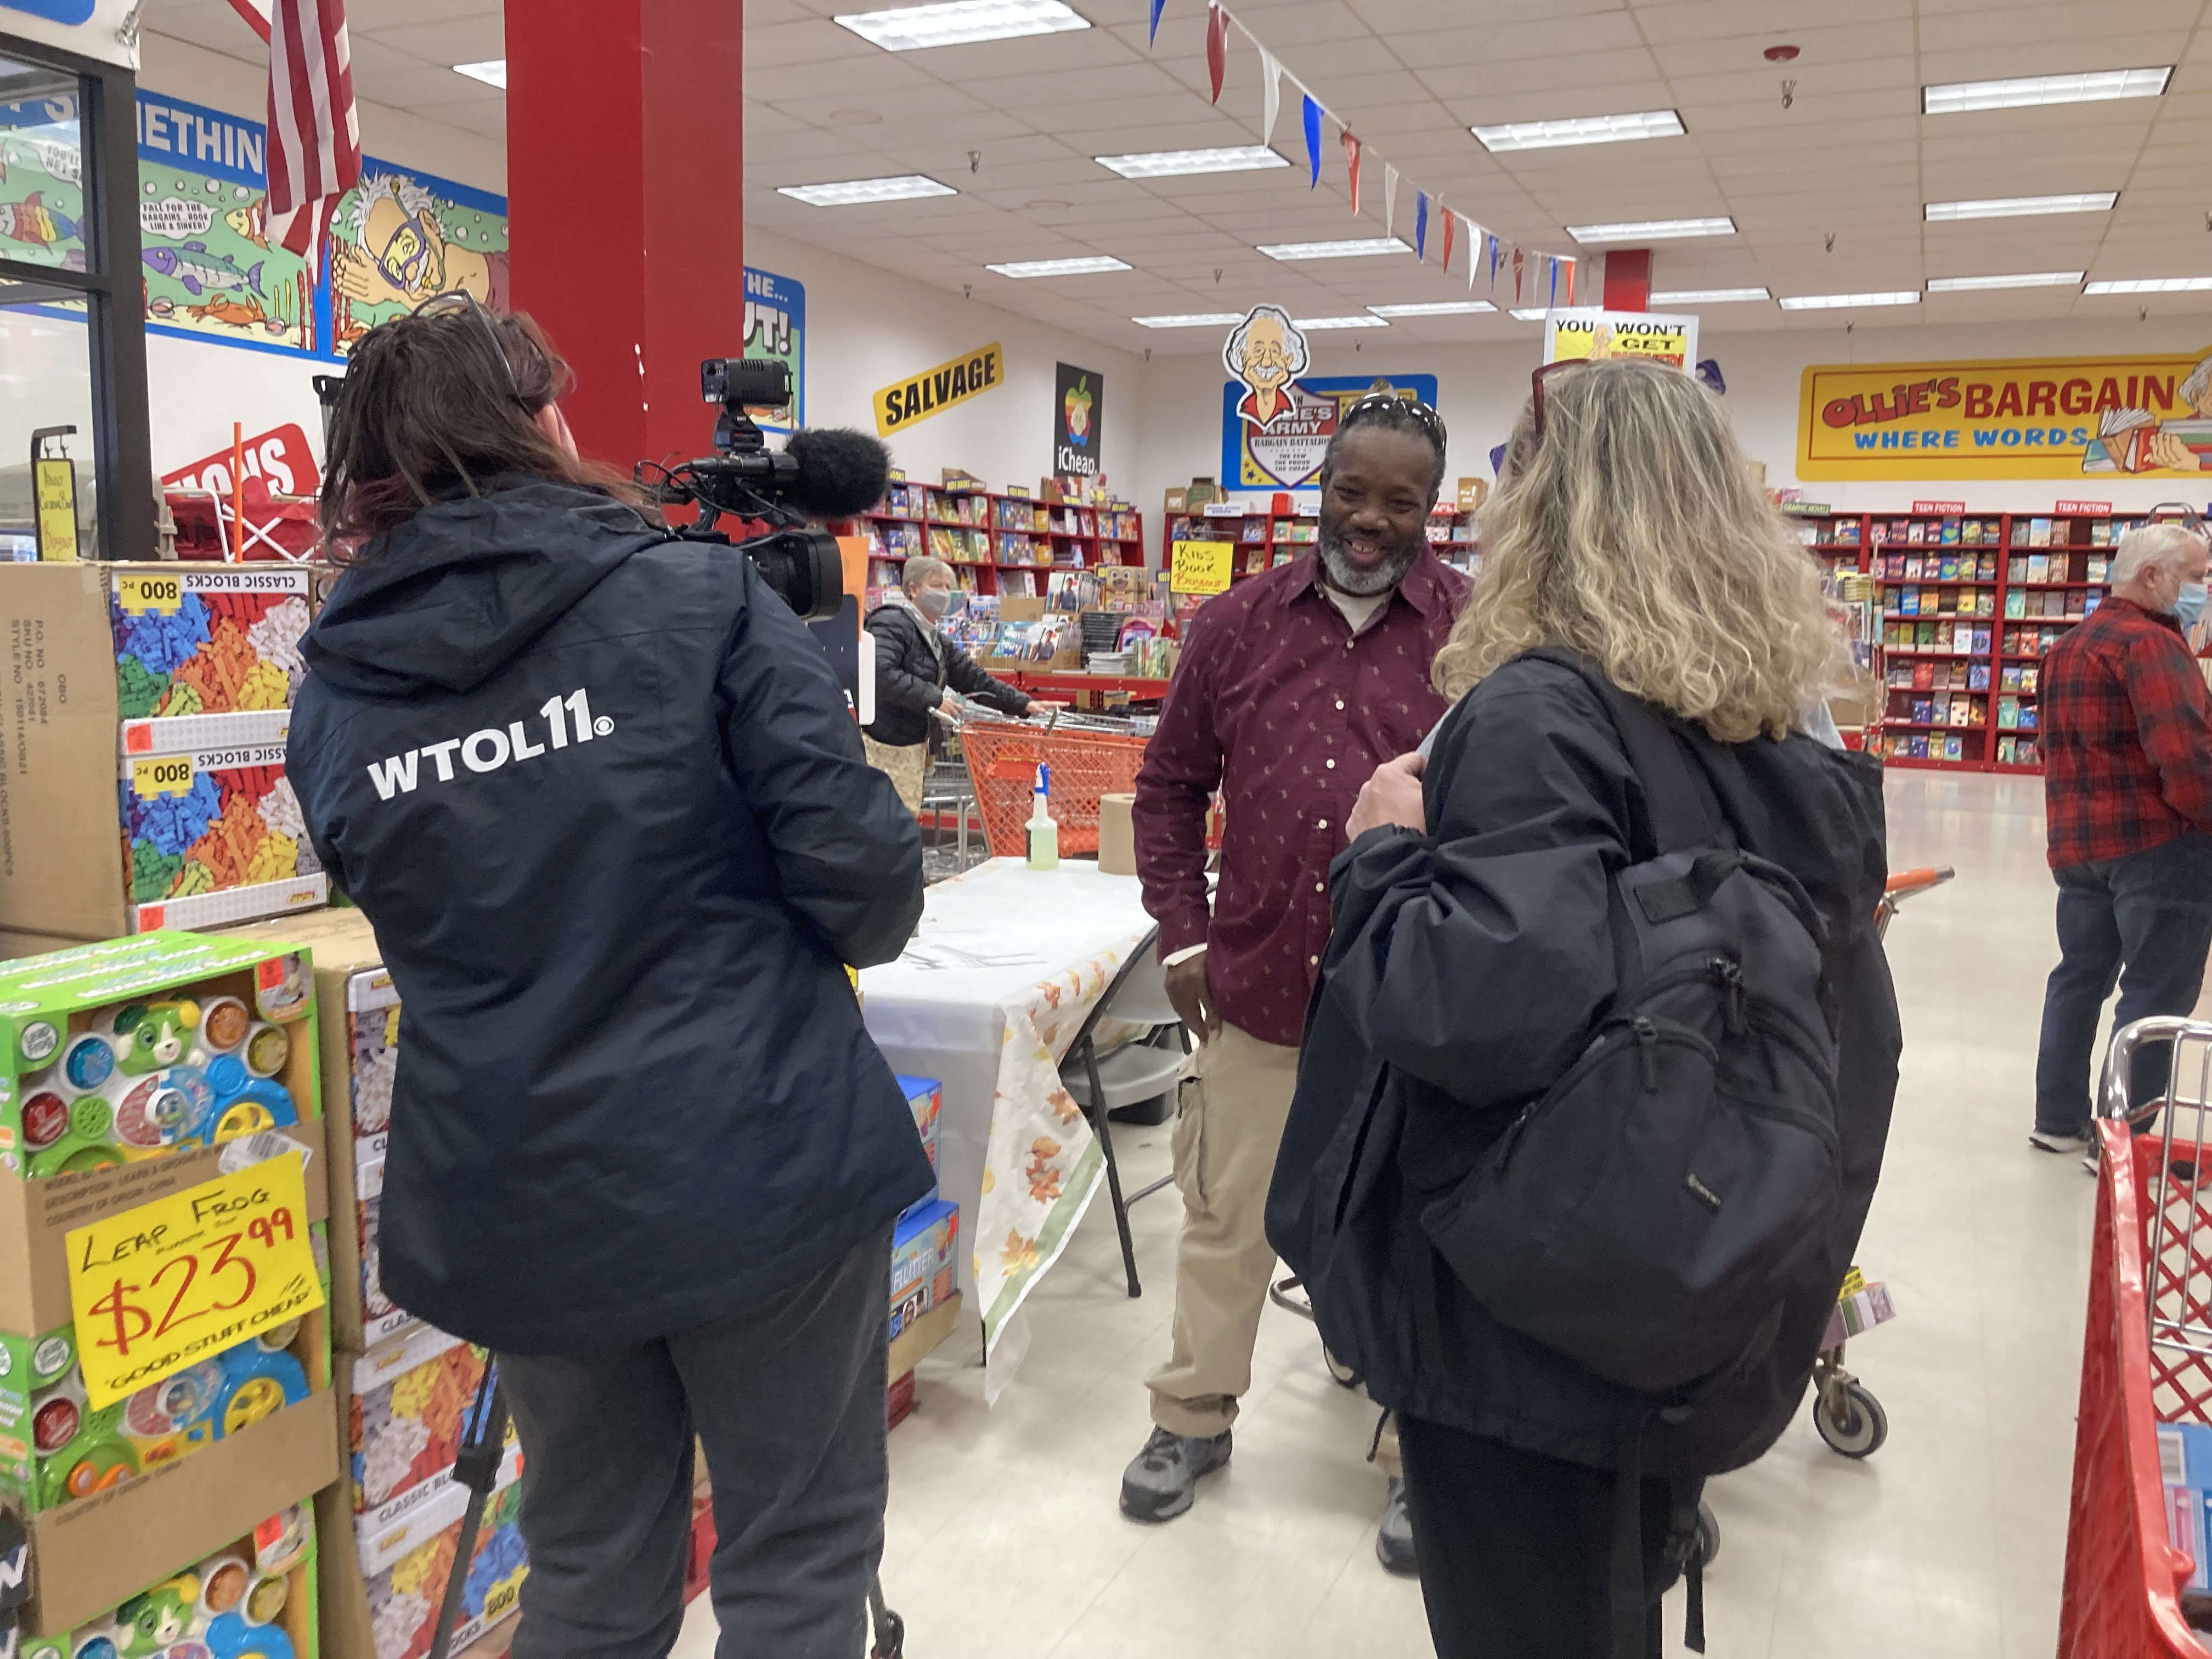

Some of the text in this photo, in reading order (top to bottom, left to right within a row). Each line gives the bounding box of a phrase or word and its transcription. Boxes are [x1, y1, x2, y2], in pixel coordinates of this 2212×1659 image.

[166, 204, 183, 212] FOR
[187, 204, 202, 212] THE
[744, 271, 788, 302] HE...
[1556, 320, 1686, 336] YOU WON'T
[1622, 338, 1675, 351] GET
[885, 351, 995, 426] SALVAGE
[1822, 375, 2175, 428] OLLIE'S BARGAIN
[1262, 421, 1322, 435] ARMY
[1255, 437, 1287, 447] BARGAIN
[1854, 427, 2088, 449] WHERE WORDS
[1783, 503, 1830, 514] GRAPHIC NOVELS
[1915, 503, 1963, 513] TEEN FICTION
[2058, 502, 2109, 513] TEEN FICTION
[1179, 544, 1214, 561] KIDS
[1175, 559, 1217, 574] BOOK
[187, 575, 296, 588] CLASSIC BLOCKS
[122, 581, 177, 600] 800 PC
[199, 751, 250, 767] BLOCKS
[137, 763, 190, 783] 800 PC
[82, 1223, 167, 1273] LEAP
[191, 1187, 270, 1224] FROG
[184, 1318, 246, 1355] STUFF
[377, 1483, 431, 1522] CLASSIC
